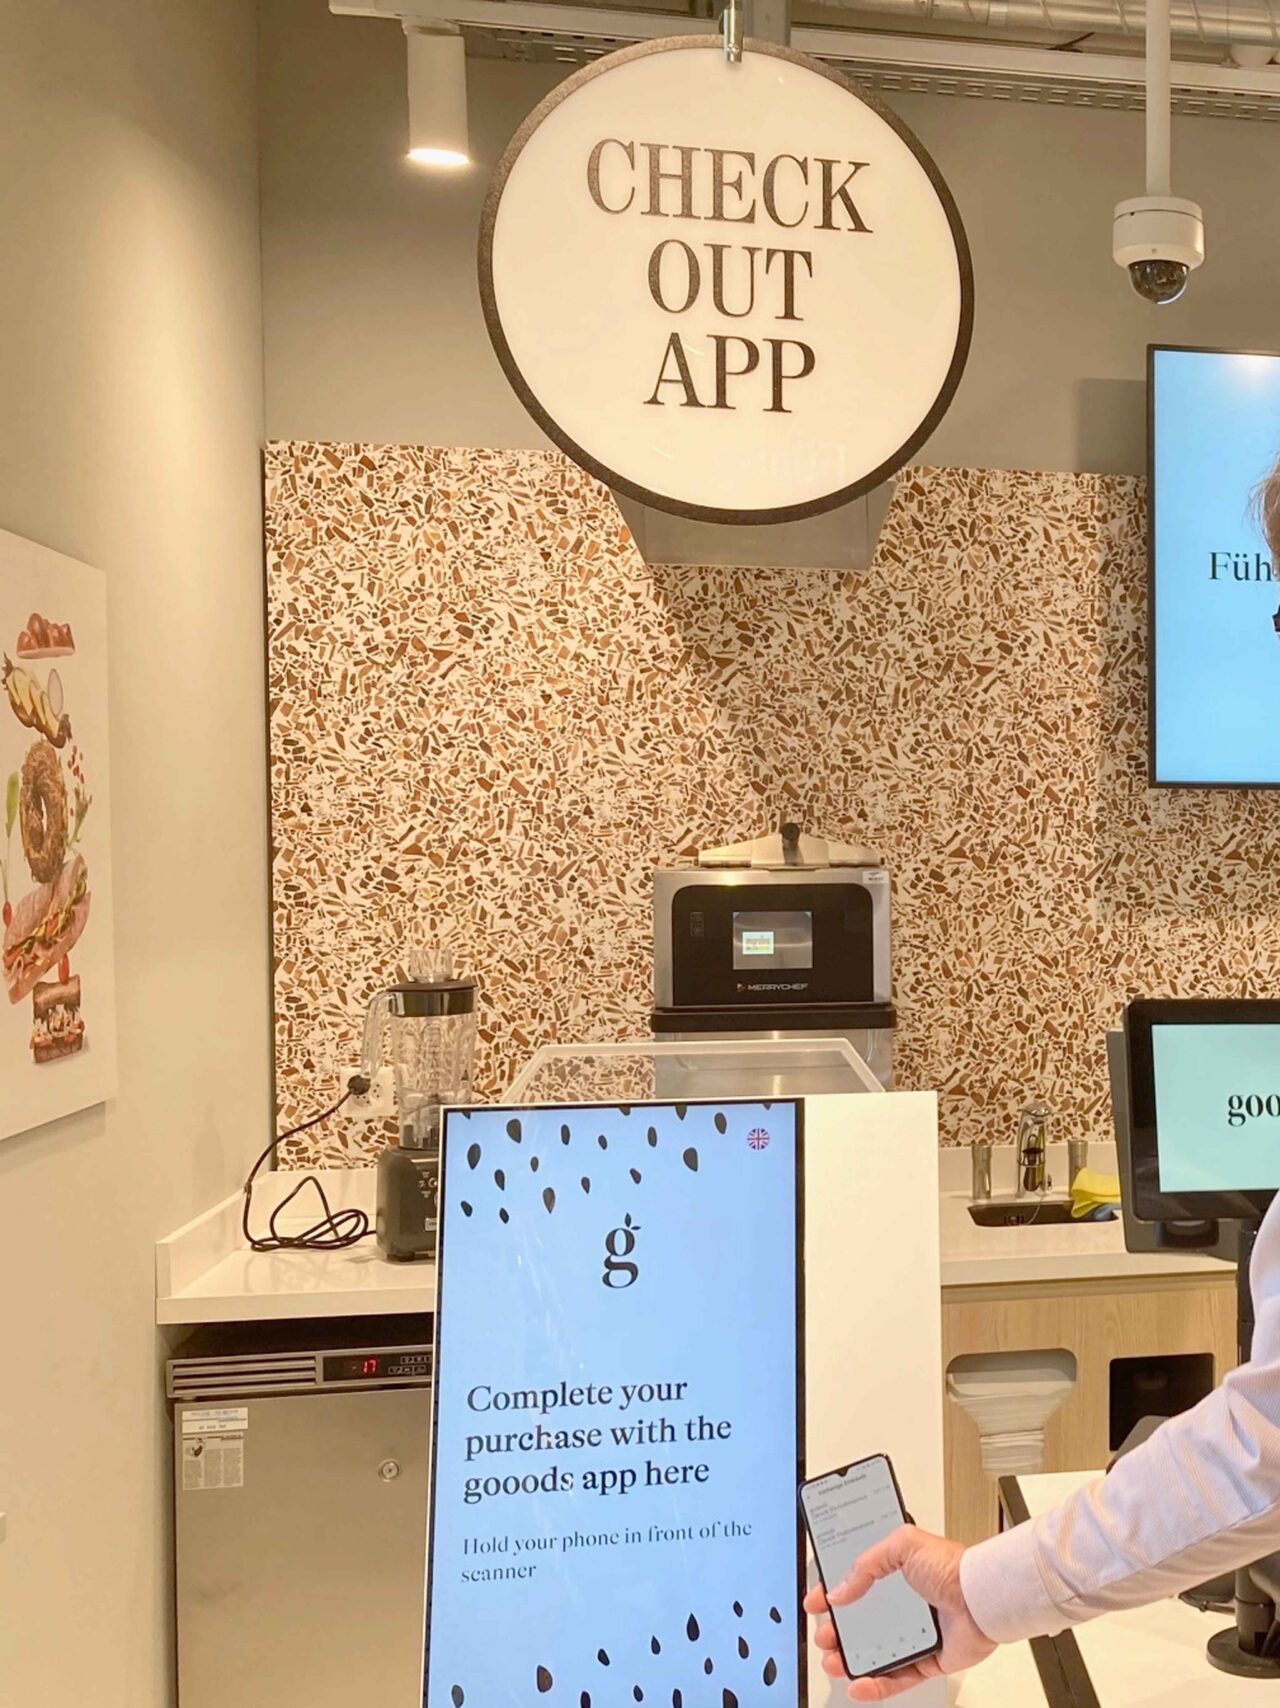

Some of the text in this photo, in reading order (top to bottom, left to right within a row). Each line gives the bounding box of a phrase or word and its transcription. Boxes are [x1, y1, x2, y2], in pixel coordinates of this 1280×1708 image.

[586, 138, 873, 234] CHECK
[647, 239, 813, 321] OUT
[643, 332, 816, 413] APP
[1208, 551, 1280, 582] Füh
[747, 983, 809, 992] MERRYCHEF
[466, 1381, 688, 1414] Complete your
[464, 1415, 732, 1461] purchase with the
[463, 1460, 710, 1505] gooods app here
[463, 1520, 752, 1556] Hold your phone in front of the
[460, 1563, 537, 1583] scanner
